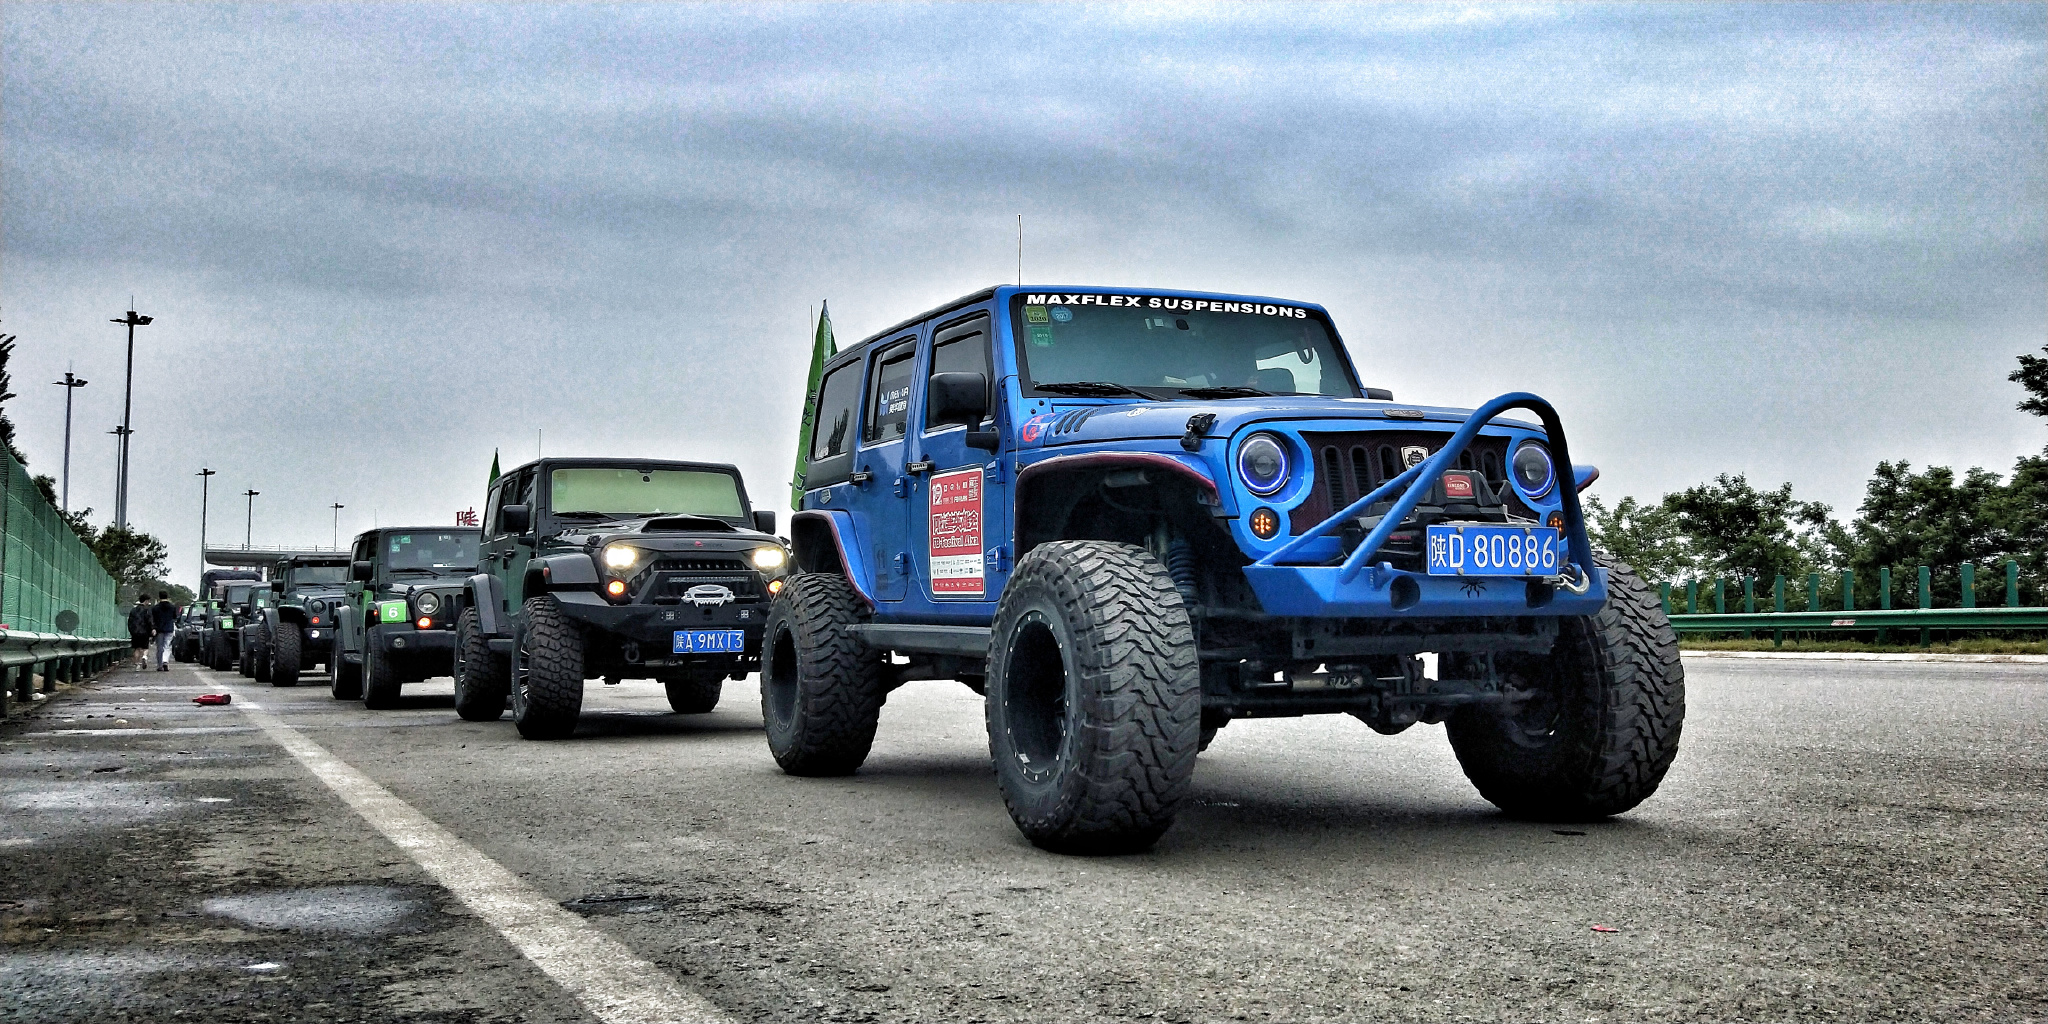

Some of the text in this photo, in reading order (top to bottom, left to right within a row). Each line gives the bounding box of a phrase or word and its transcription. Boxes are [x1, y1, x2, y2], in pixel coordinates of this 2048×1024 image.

[1026, 293, 1307, 320] MAXFLEX SUSPENSIONS
[1430, 533, 1556, 569] 陕D·80886
[388, 606, 399, 619] 6
[675, 632, 744, 650] 陕A·9MX13
